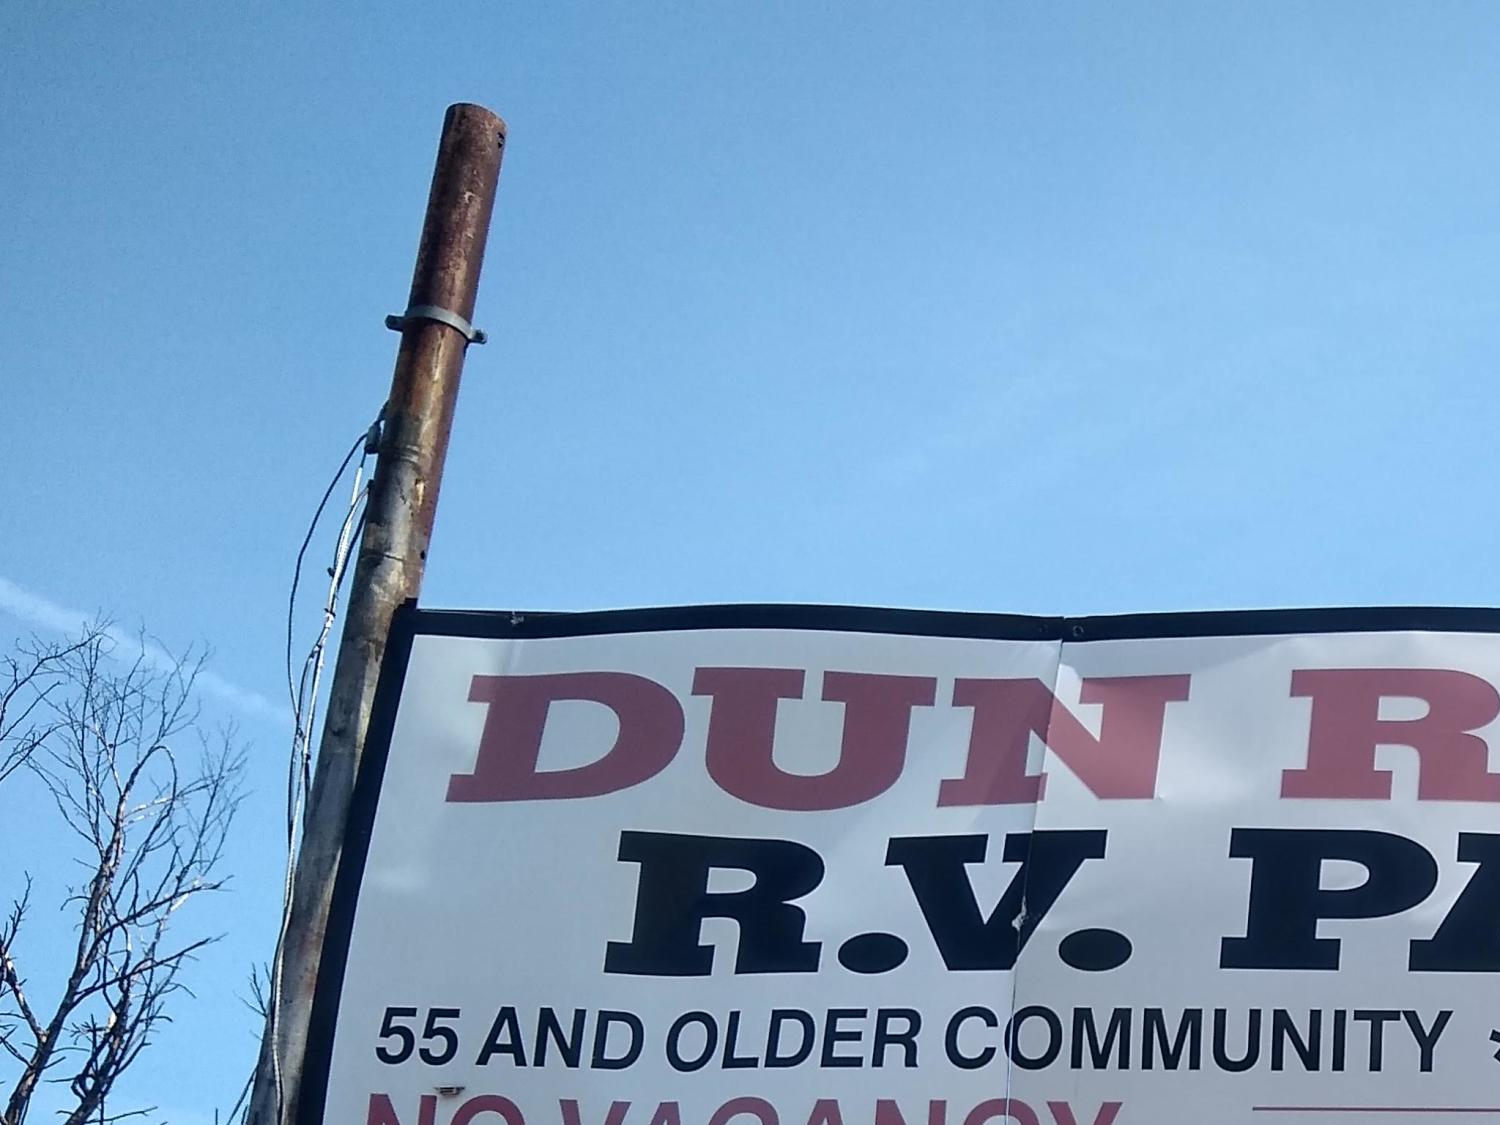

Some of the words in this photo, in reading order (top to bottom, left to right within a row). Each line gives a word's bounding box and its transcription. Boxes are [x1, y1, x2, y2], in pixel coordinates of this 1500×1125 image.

[446, 667, 1191, 811] DUN
[603, 829, 1133, 977] R.V.
[375, 1006, 461, 1066] 55
[475, 1006, 645, 1070] AND
[665, 1008, 922, 1073] OLDER
[944, 1006, 1454, 1073] COMMUNITY
